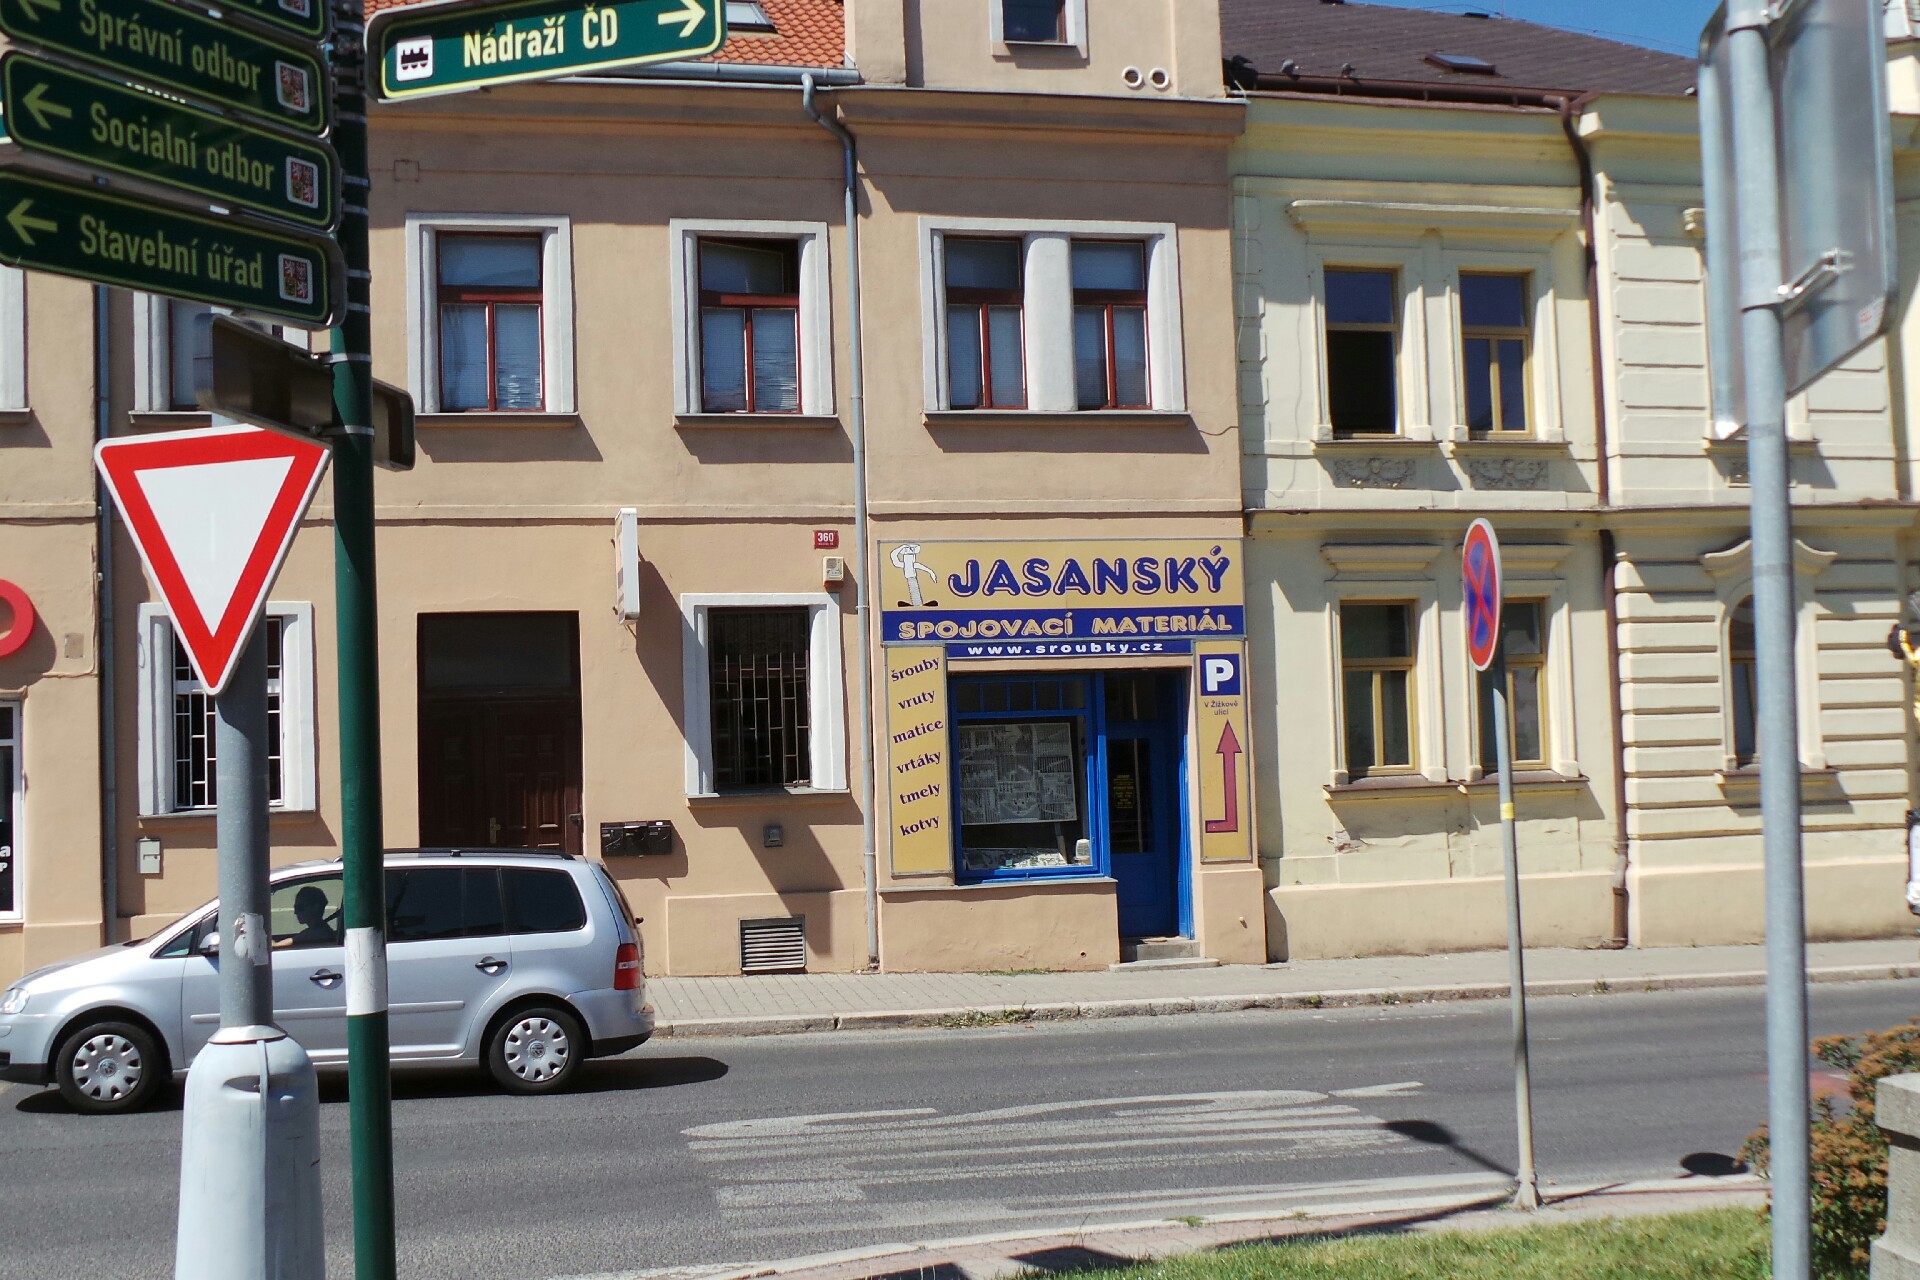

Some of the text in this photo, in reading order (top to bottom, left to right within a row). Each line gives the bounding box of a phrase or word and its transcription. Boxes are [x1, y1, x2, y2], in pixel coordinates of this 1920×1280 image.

[80, 0, 260, 91] Správní odbor
[464, 3, 618, 68] Nádraží ČD
[90, 102, 274, 190] Socialní odbor
[80, 214, 263, 289] Stavební úřad
[817, 532, 834, 542] 360
[948, 544, 1230, 597] JASANSKÝ
[899, 608, 1233, 639] SPOJOVACÍ MATERIÁL
[967, 642, 1163, 655] www.sroubky.cz
[891, 657, 940, 682] šrouby
[1205, 658, 1234, 692] P
[898, 690, 935, 709] vruty
[893, 720, 943, 743] matice
[896, 751, 941, 774] vrtáky
[899, 783, 941, 804] tmely
[900, 815, 940, 836] kotvy
